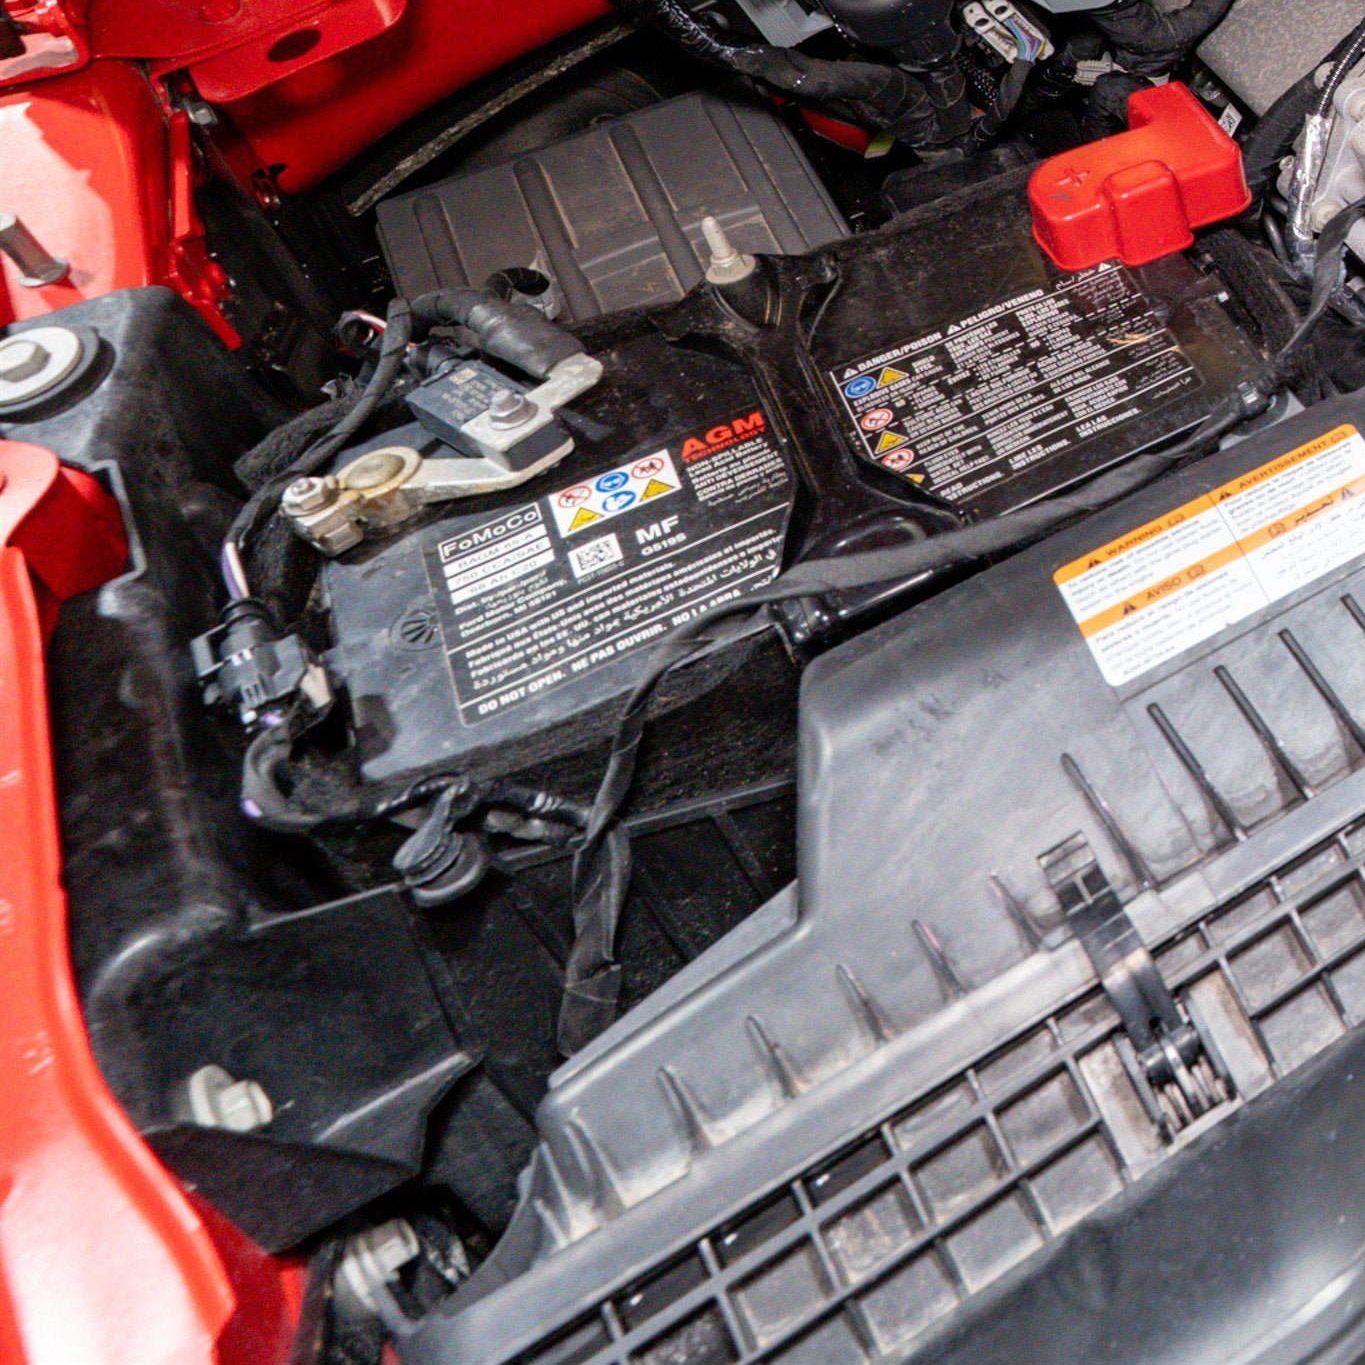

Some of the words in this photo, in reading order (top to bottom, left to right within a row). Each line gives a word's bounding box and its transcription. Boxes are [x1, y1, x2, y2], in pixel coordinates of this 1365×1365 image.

[961, 288, 1044, 330] PELIGRO/VENENO
[858, 332, 942, 374] DANGER/POISON
[680, 410, 764, 459] AGM
[684, 425, 767, 466] TECHNOLOGY
[688, 438, 763, 474] NON-SPILLABLE
[1239, 441, 1328, 490] AVERTISSEMENT
[444, 509, 538, 558] FoMoCo
[636, 514, 681, 547] MF
[1107, 525, 1163, 558] WARNING
[584, 602, 605, 617] avec
[607, 593, 624, 607] des
[724, 547, 733, 556] et
[1147, 577, 1182, 601] AVISO
[460, 616, 484, 631] Ford
[486, 602, 515, 620] Motor
[466, 642, 493, 660] Made
[496, 637, 506, 647] in
[508, 627, 528, 642] USA
[530, 617, 550, 632] with
[567, 601, 585, 614] and
[587, 581, 628, 605] imported
[630, 560, 676, 586] materials.
[541, 636, 555, 649] los
[594, 611, 611, 623] con
[612, 587, 662, 615] materiales
[479, 700, 498, 716] DO
[500, 687, 527, 707] NOT
[529, 669, 567, 694] OPEN.
[572, 658, 590, 674] NE
[591, 646, 615, 665] PAS
[617, 621, 668, 652] OUVRIR.
[673, 612, 691, 628] NO
